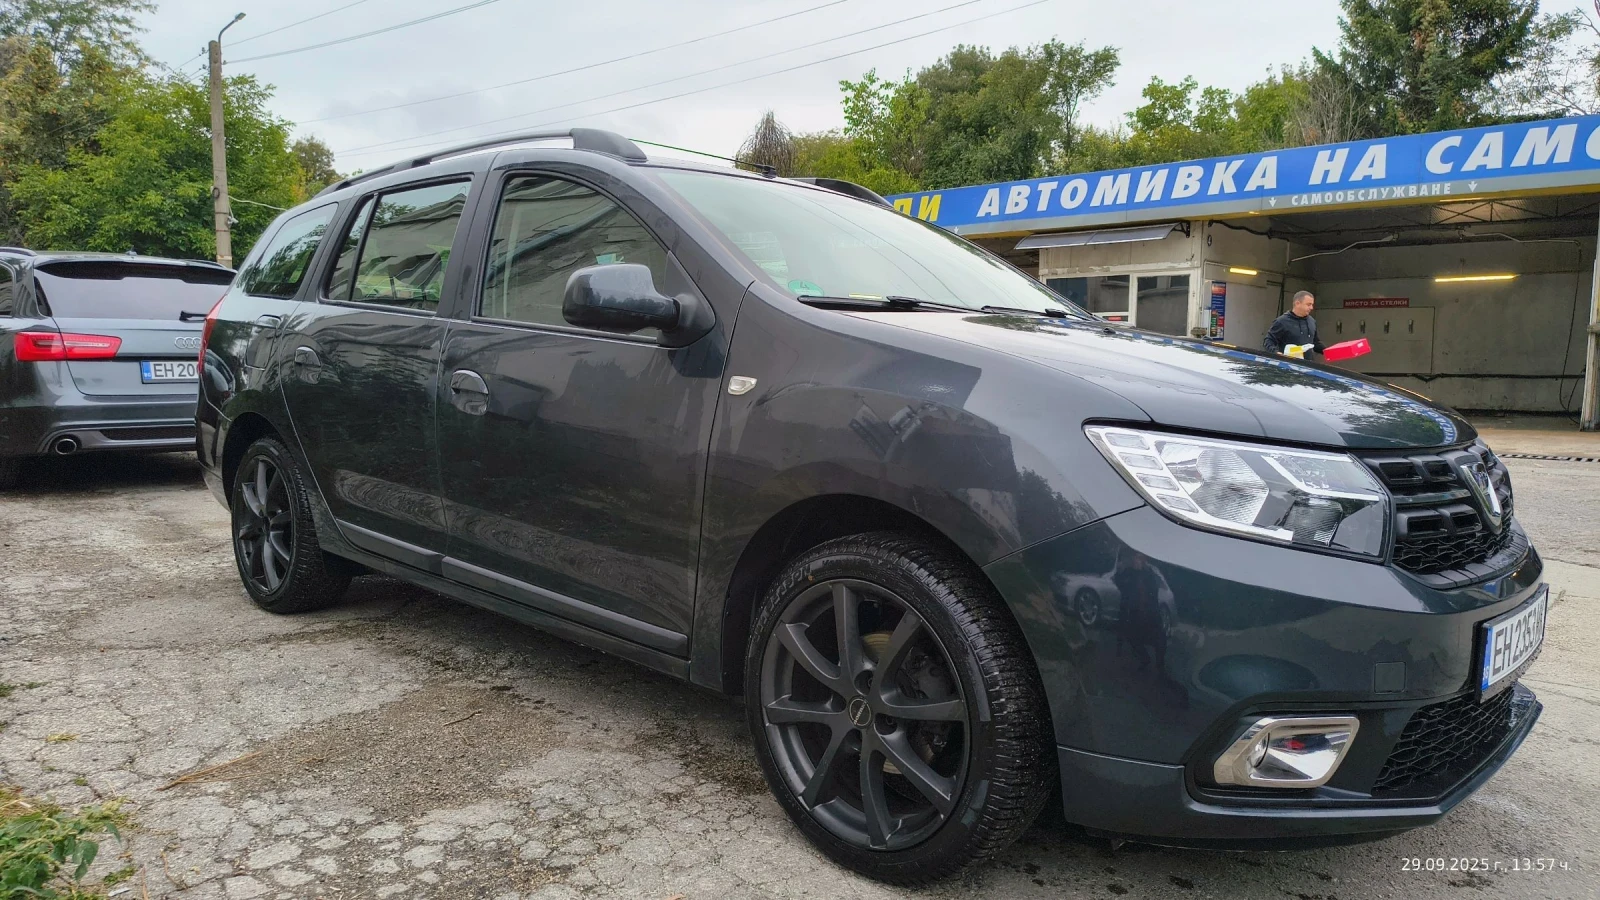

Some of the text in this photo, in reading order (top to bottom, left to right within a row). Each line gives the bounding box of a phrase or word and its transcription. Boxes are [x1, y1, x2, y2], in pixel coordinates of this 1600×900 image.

[976, 156, 1278, 218] АВТОМИВКА
[1308, 144, 1387, 185] НА
[1291, 182, 1451, 206] САМООБСЛУЖВАНЕ
[153, 363, 175, 378] EH
[1493, 623, 1513, 676] EH
